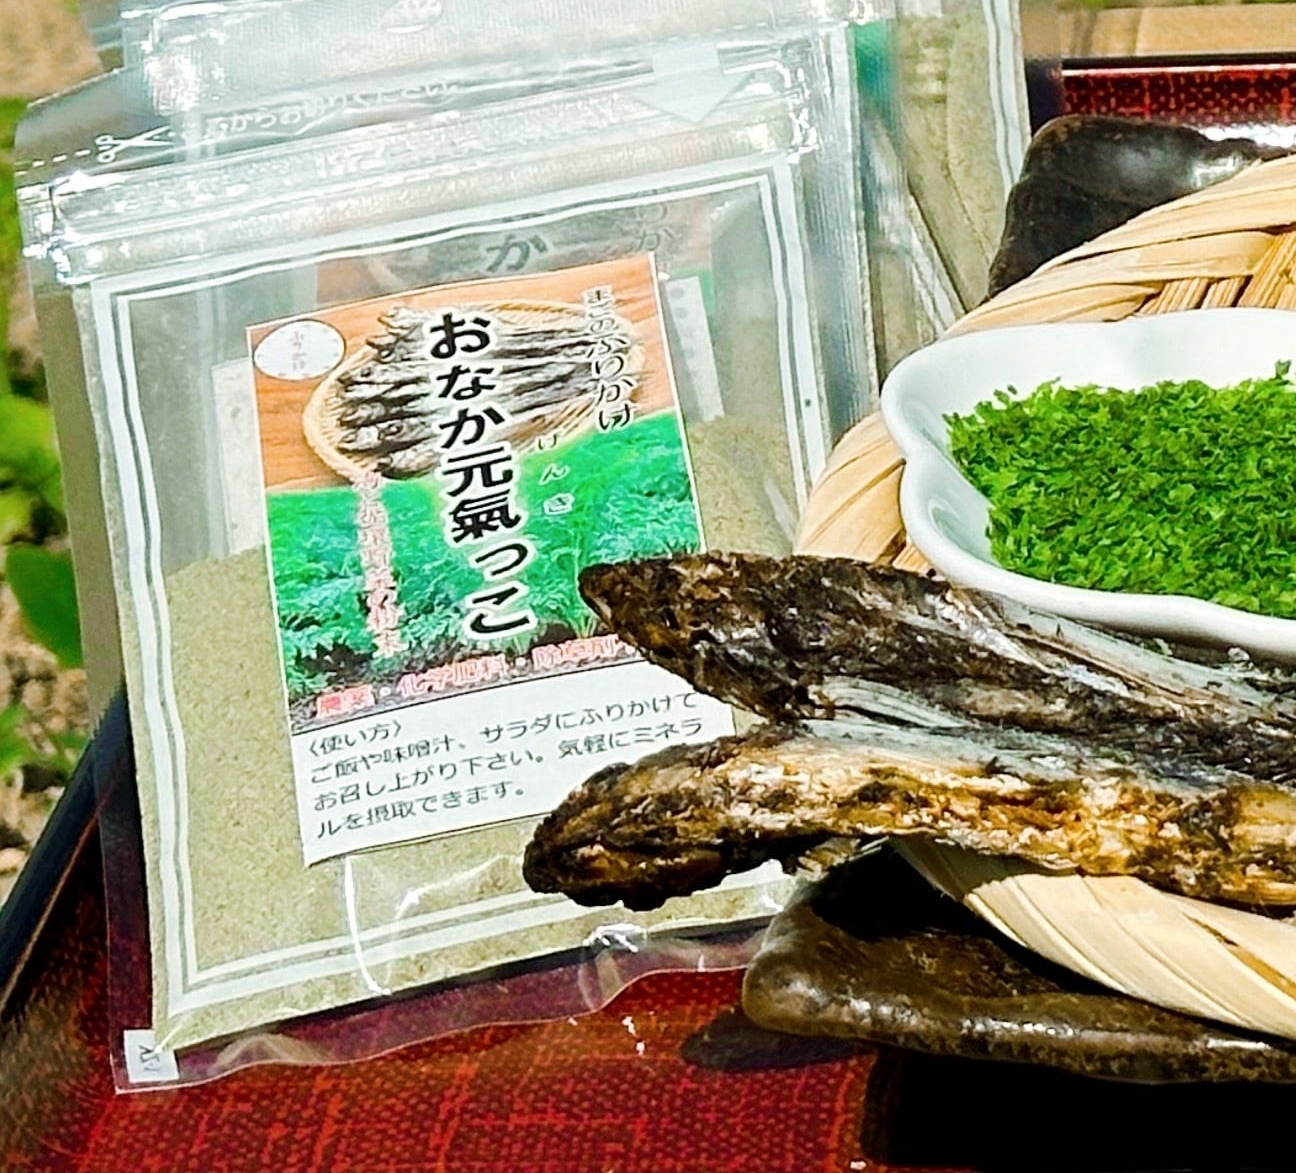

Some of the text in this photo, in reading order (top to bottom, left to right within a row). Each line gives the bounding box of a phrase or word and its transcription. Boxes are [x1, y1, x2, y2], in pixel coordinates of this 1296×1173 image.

[430, 312, 534, 637] おなか元氣っこ
[310, 691, 698, 784] ご飯や味噌汁、サラダにふりかけて
[314, 717, 702, 812] お召し上がり下さい。気軽にミネラ
[317, 779, 524, 839] ルを摂取できます。
